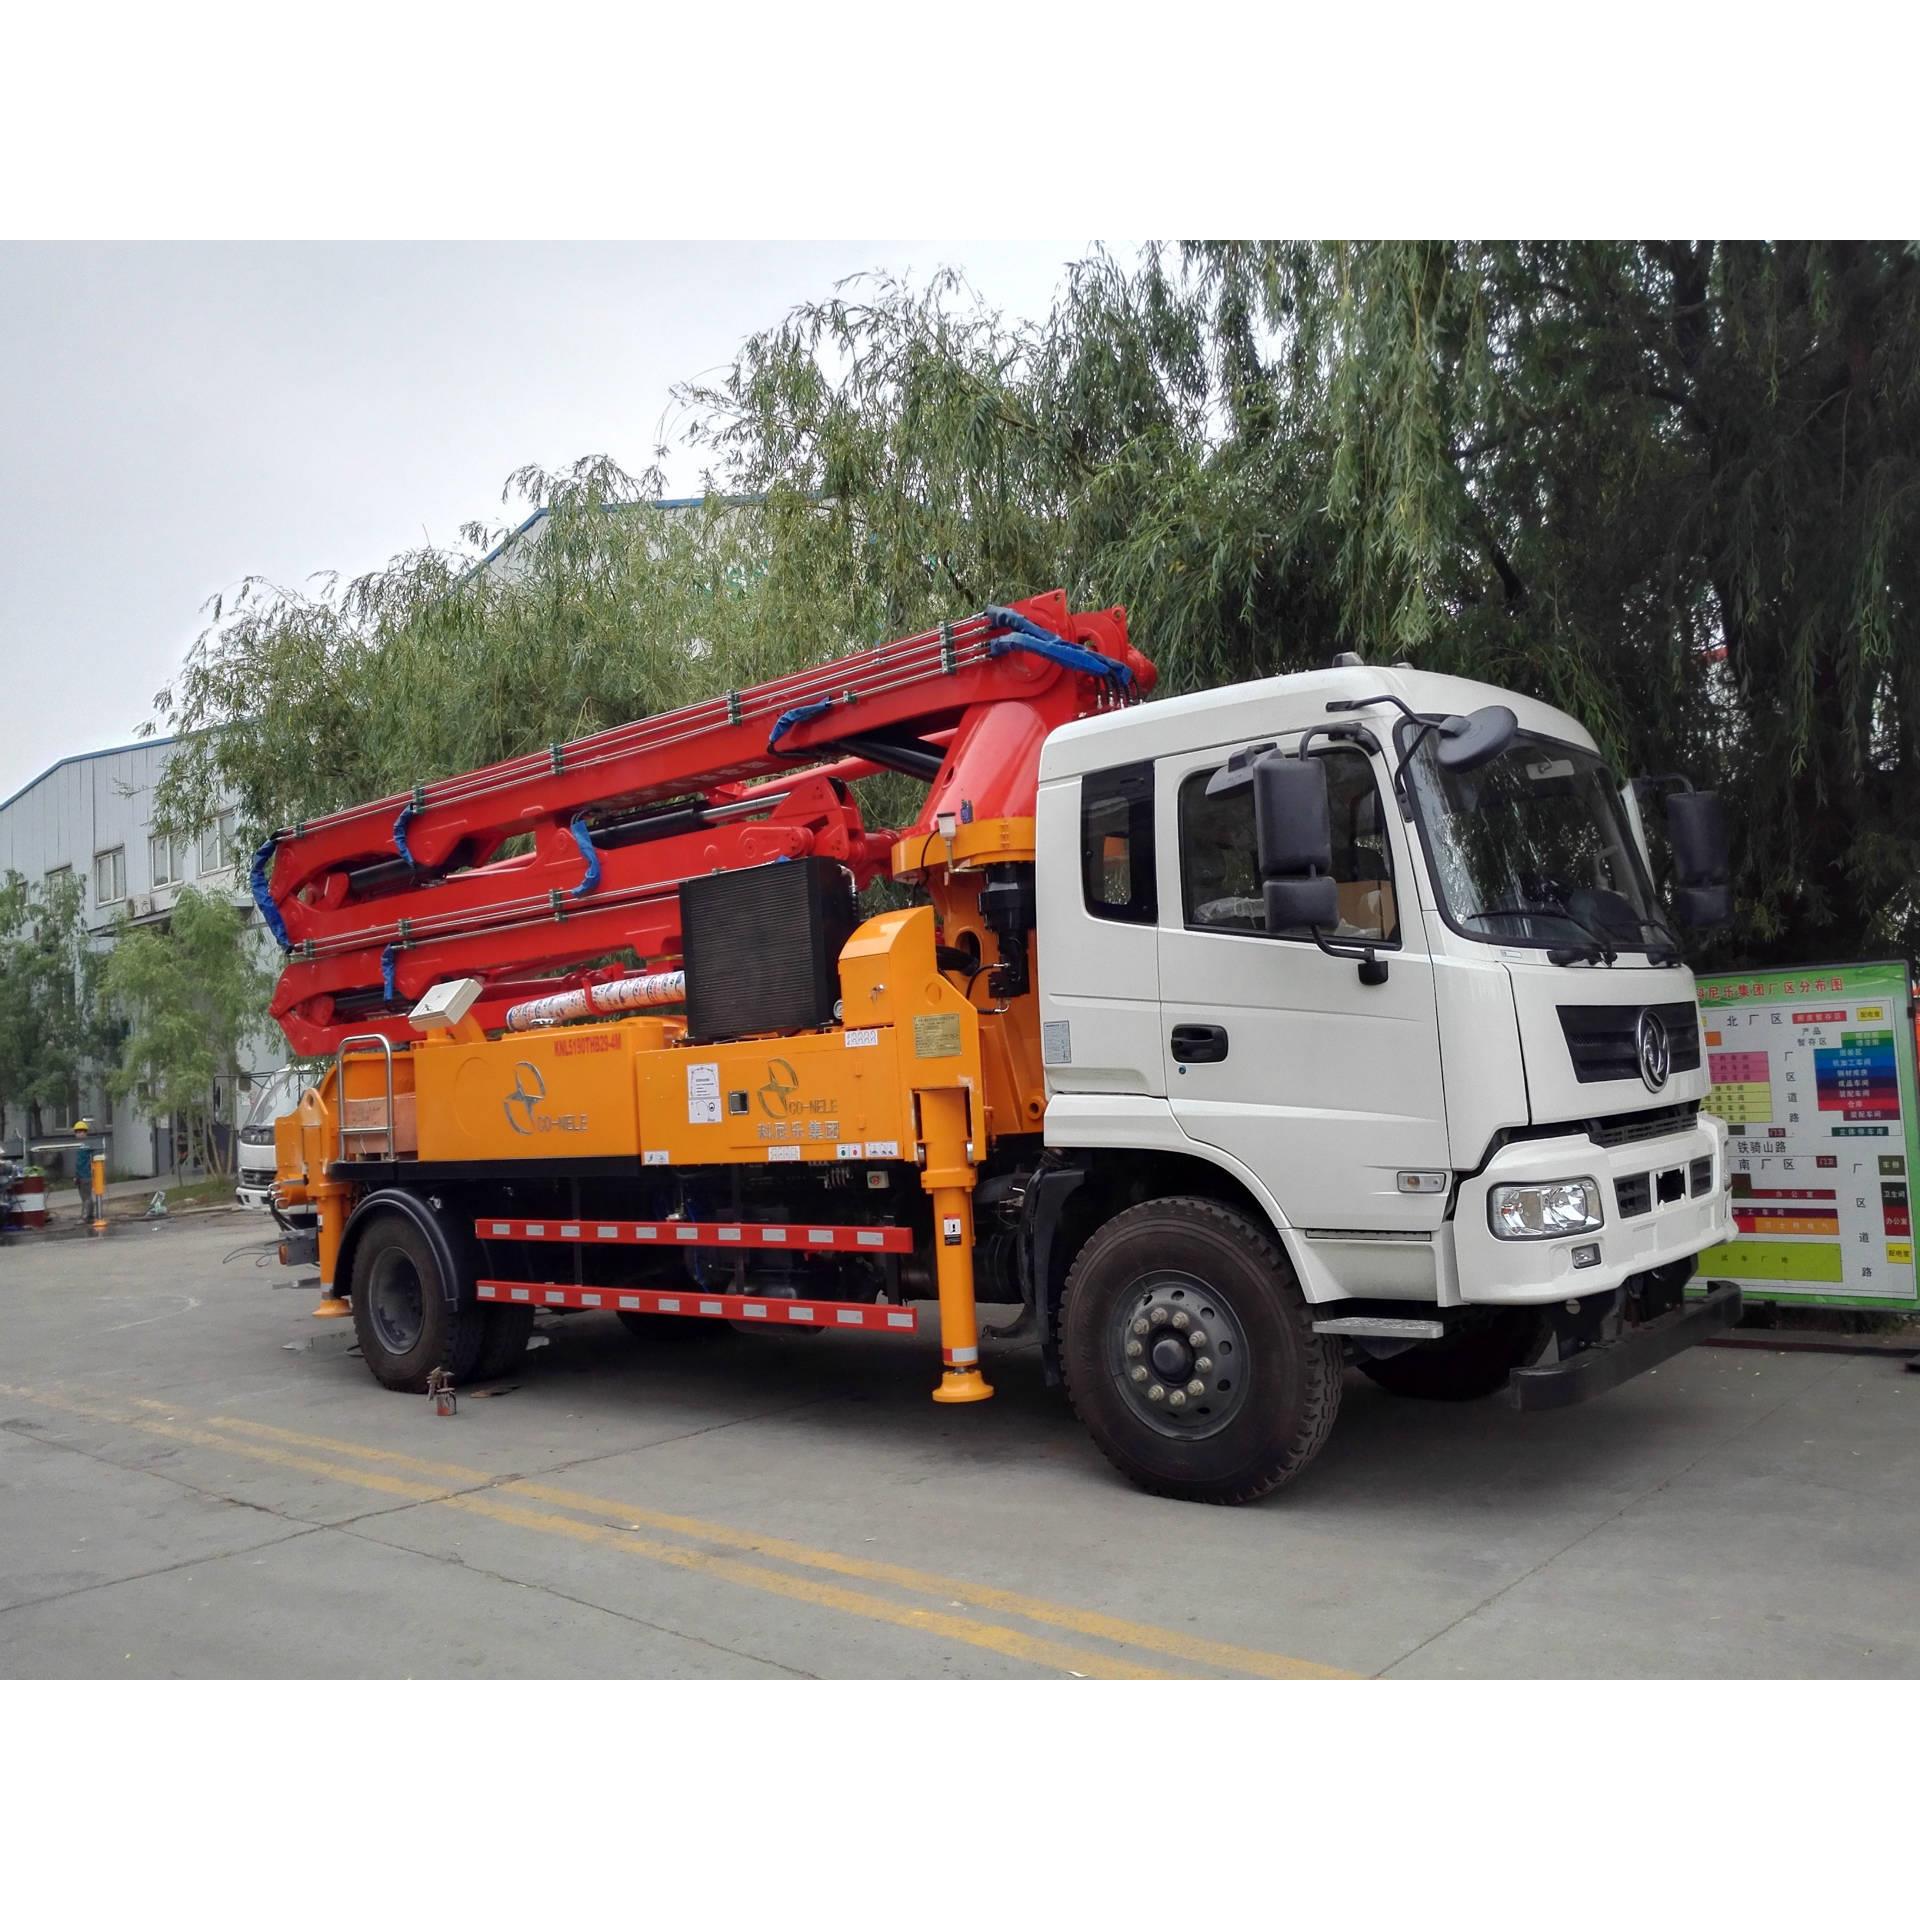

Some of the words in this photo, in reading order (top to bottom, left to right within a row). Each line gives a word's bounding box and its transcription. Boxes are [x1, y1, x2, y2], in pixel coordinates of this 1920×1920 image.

[1727, 1013, 1783, 1027] 北厂区
[788, 1098, 838, 1115] CO-NELE
[1737, 1141, 1786, 1154] 铁骑山路
[1738, 1158, 1795, 1171] 南厂区
